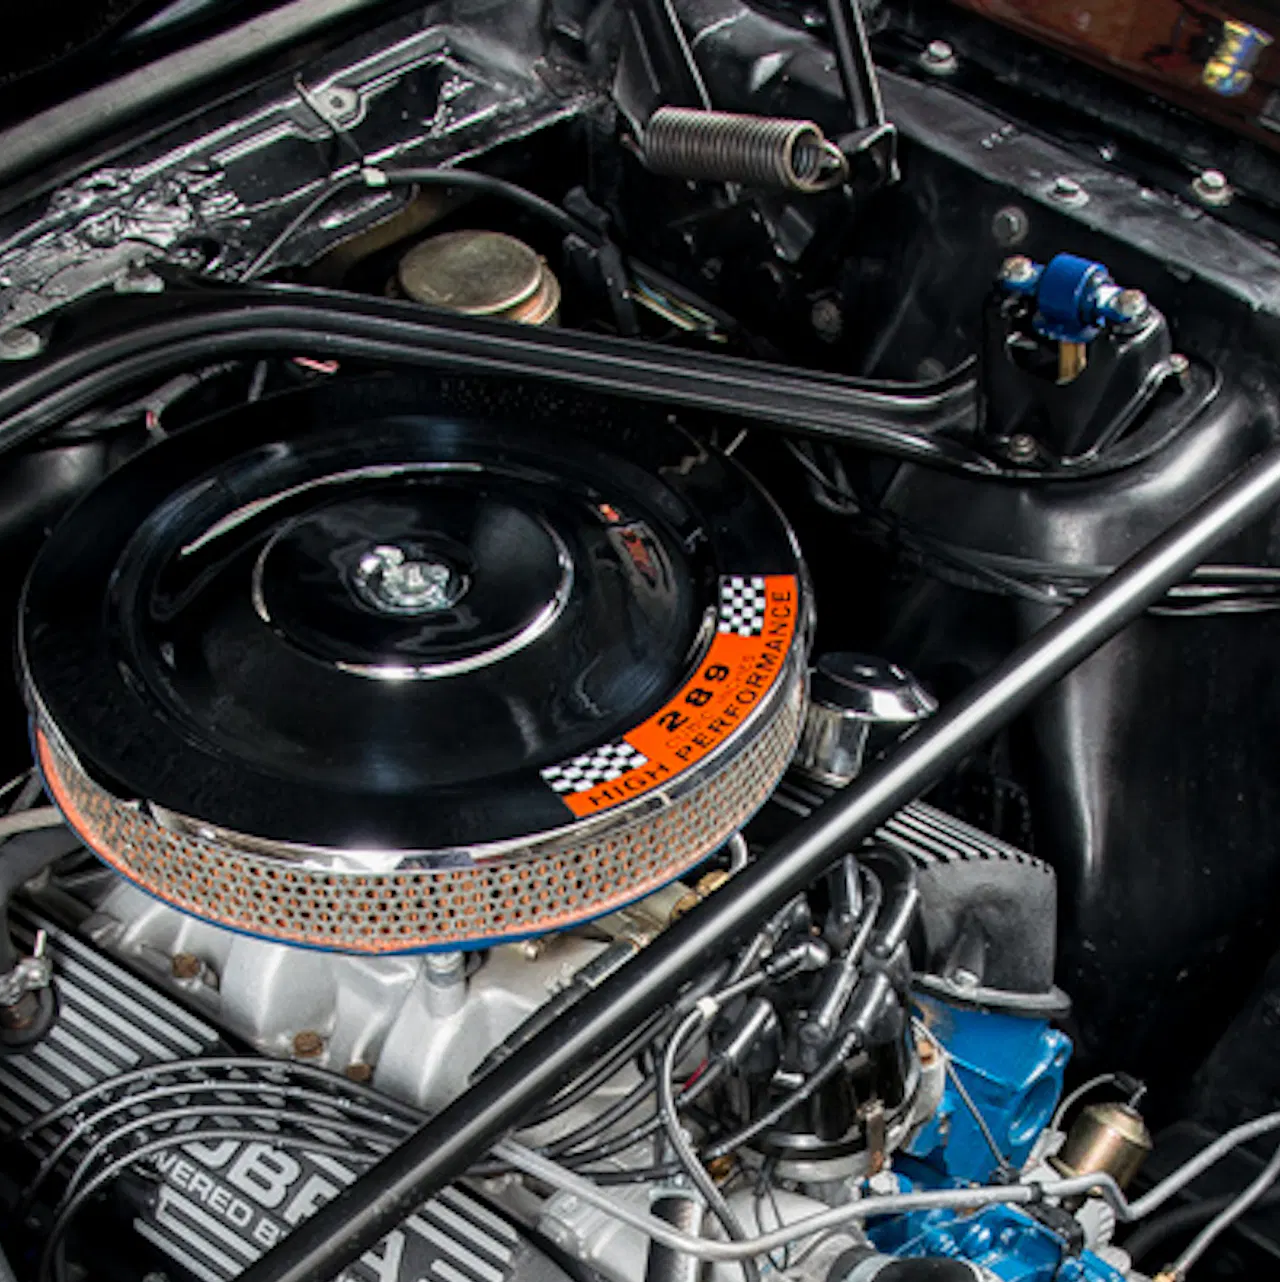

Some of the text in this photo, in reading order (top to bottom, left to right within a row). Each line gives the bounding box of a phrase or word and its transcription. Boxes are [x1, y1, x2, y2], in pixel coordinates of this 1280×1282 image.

[588, 585, 791, 806] HIGH PERFORMANCE
[656, 661, 732, 734] 289
[250, 1218, 286, 1252] B
